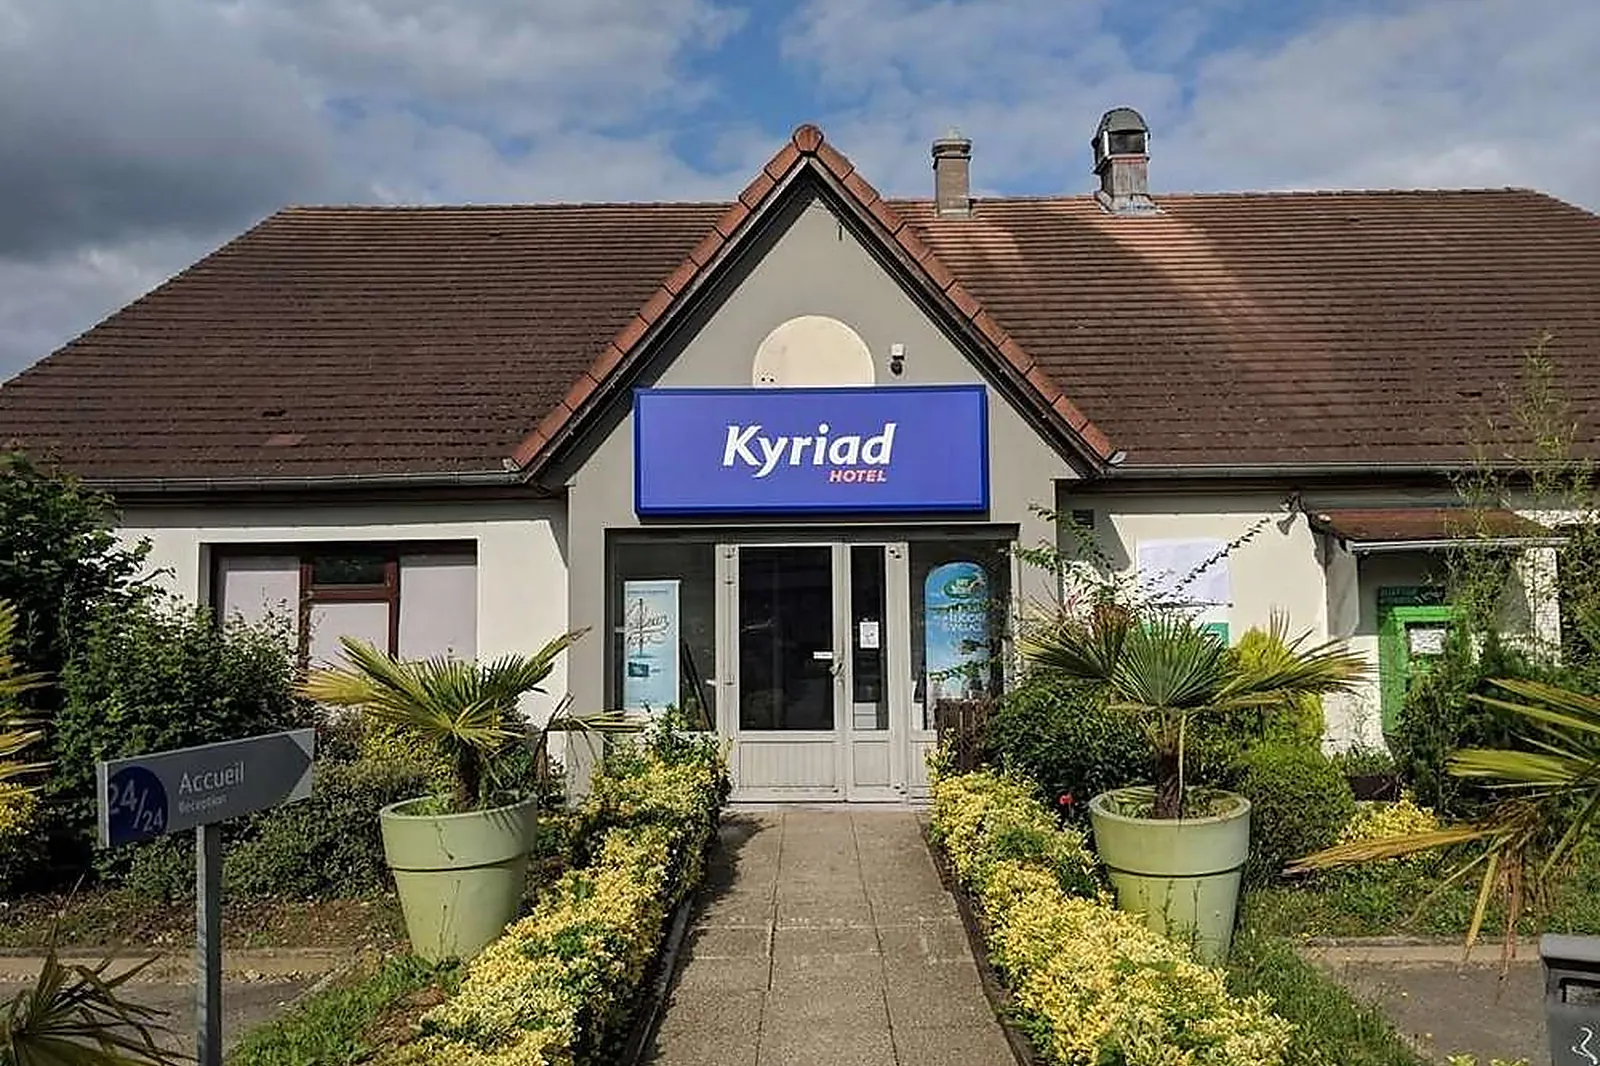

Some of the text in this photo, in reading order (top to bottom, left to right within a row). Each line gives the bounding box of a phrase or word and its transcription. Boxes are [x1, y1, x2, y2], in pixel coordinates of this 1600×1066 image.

[722, 423, 897, 479] Kyriad
[829, 469, 888, 483] HOTEL
[178, 761, 245, 795] Accueil
